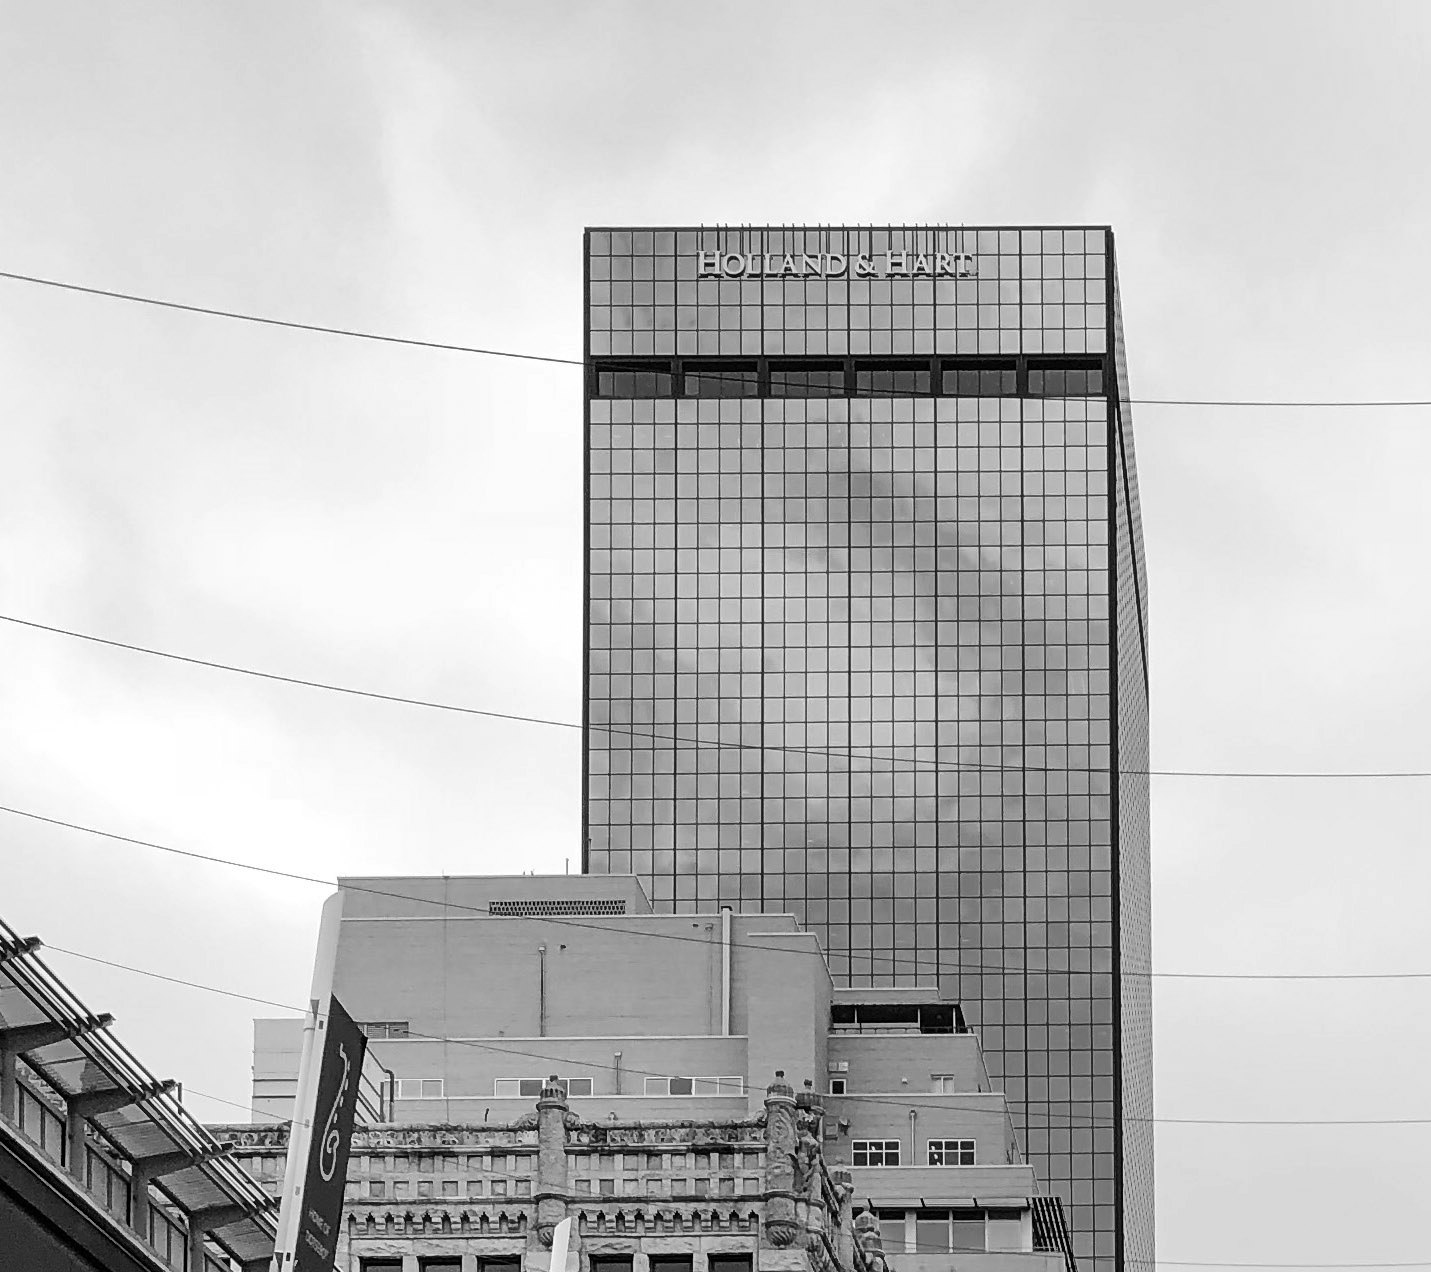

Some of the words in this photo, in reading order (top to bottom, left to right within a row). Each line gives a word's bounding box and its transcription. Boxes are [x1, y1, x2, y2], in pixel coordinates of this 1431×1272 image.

[699, 248, 846, 277] HOLLAND
[855, 251, 875, 277] &
[884, 249, 974, 277] HART
